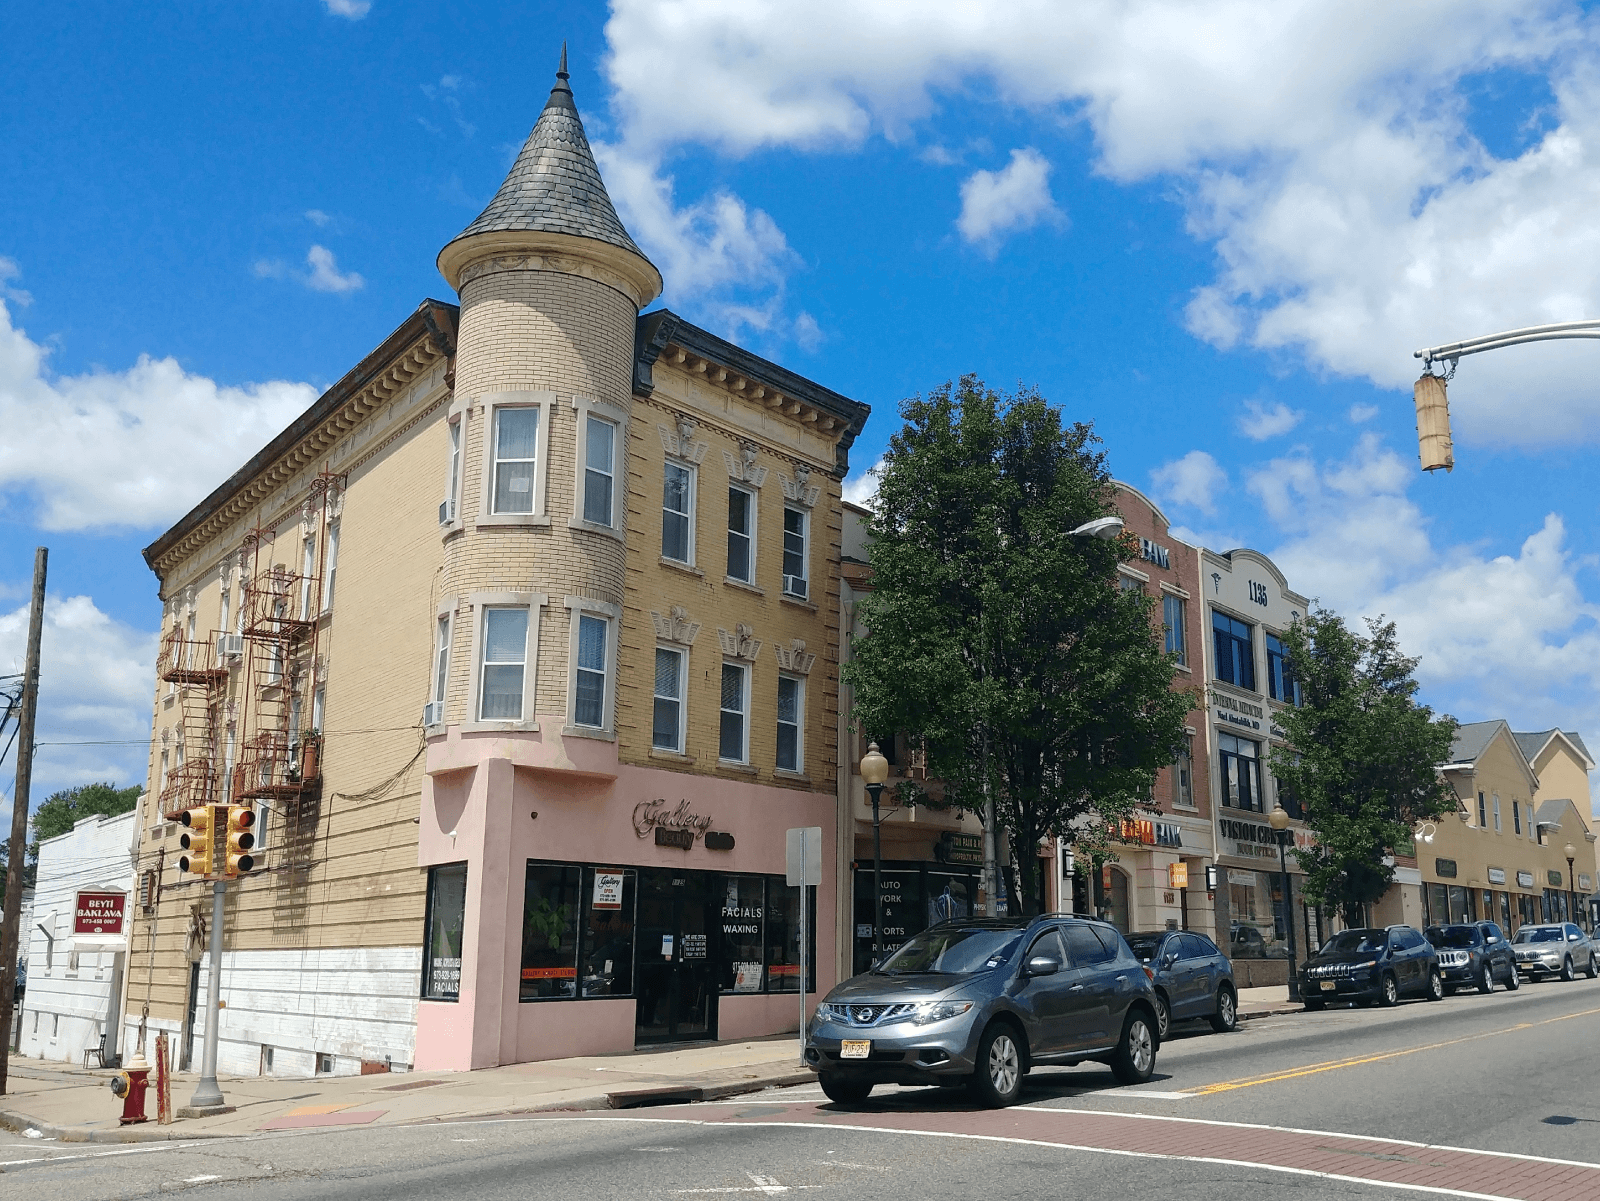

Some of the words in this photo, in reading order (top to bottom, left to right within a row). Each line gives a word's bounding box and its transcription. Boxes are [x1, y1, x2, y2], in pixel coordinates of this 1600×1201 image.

[1140, 536, 1171, 571] BANK
[1248, 579, 1268, 607] 1135
[632, 798, 714, 840] Gallery
[1155, 822, 1183, 848] BANK
[1219, 819, 1257, 842] VISION
[1257, 825, 1295, 846] CENER
[77, 909, 122, 917] BAKLAVA
[721, 907, 762, 918] FACIALS
[886, 908, 892, 916] &
[723, 924, 759, 934] WAXING
[873, 927, 905, 935] SORTS
[434, 982, 459, 993] FACIALS
